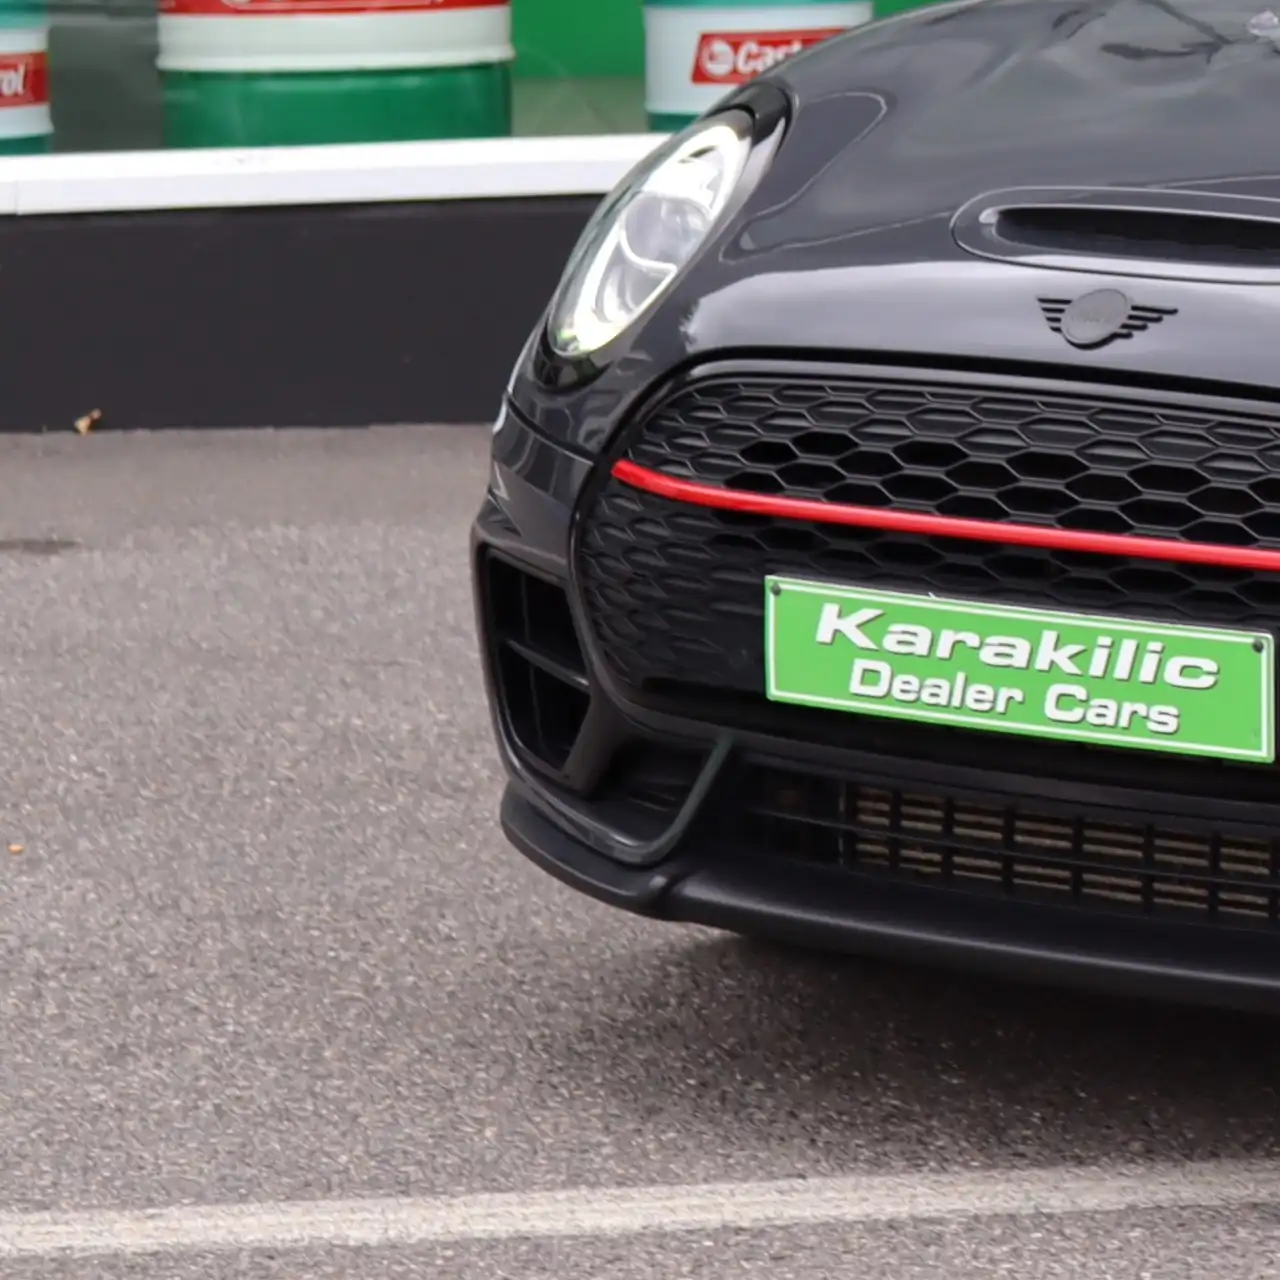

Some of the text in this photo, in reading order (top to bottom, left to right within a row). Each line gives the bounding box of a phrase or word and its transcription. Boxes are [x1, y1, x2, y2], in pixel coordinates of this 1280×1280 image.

[814, 602, 1221, 690] Karakilic
[849, 658, 1181, 735] Dealer Cars
